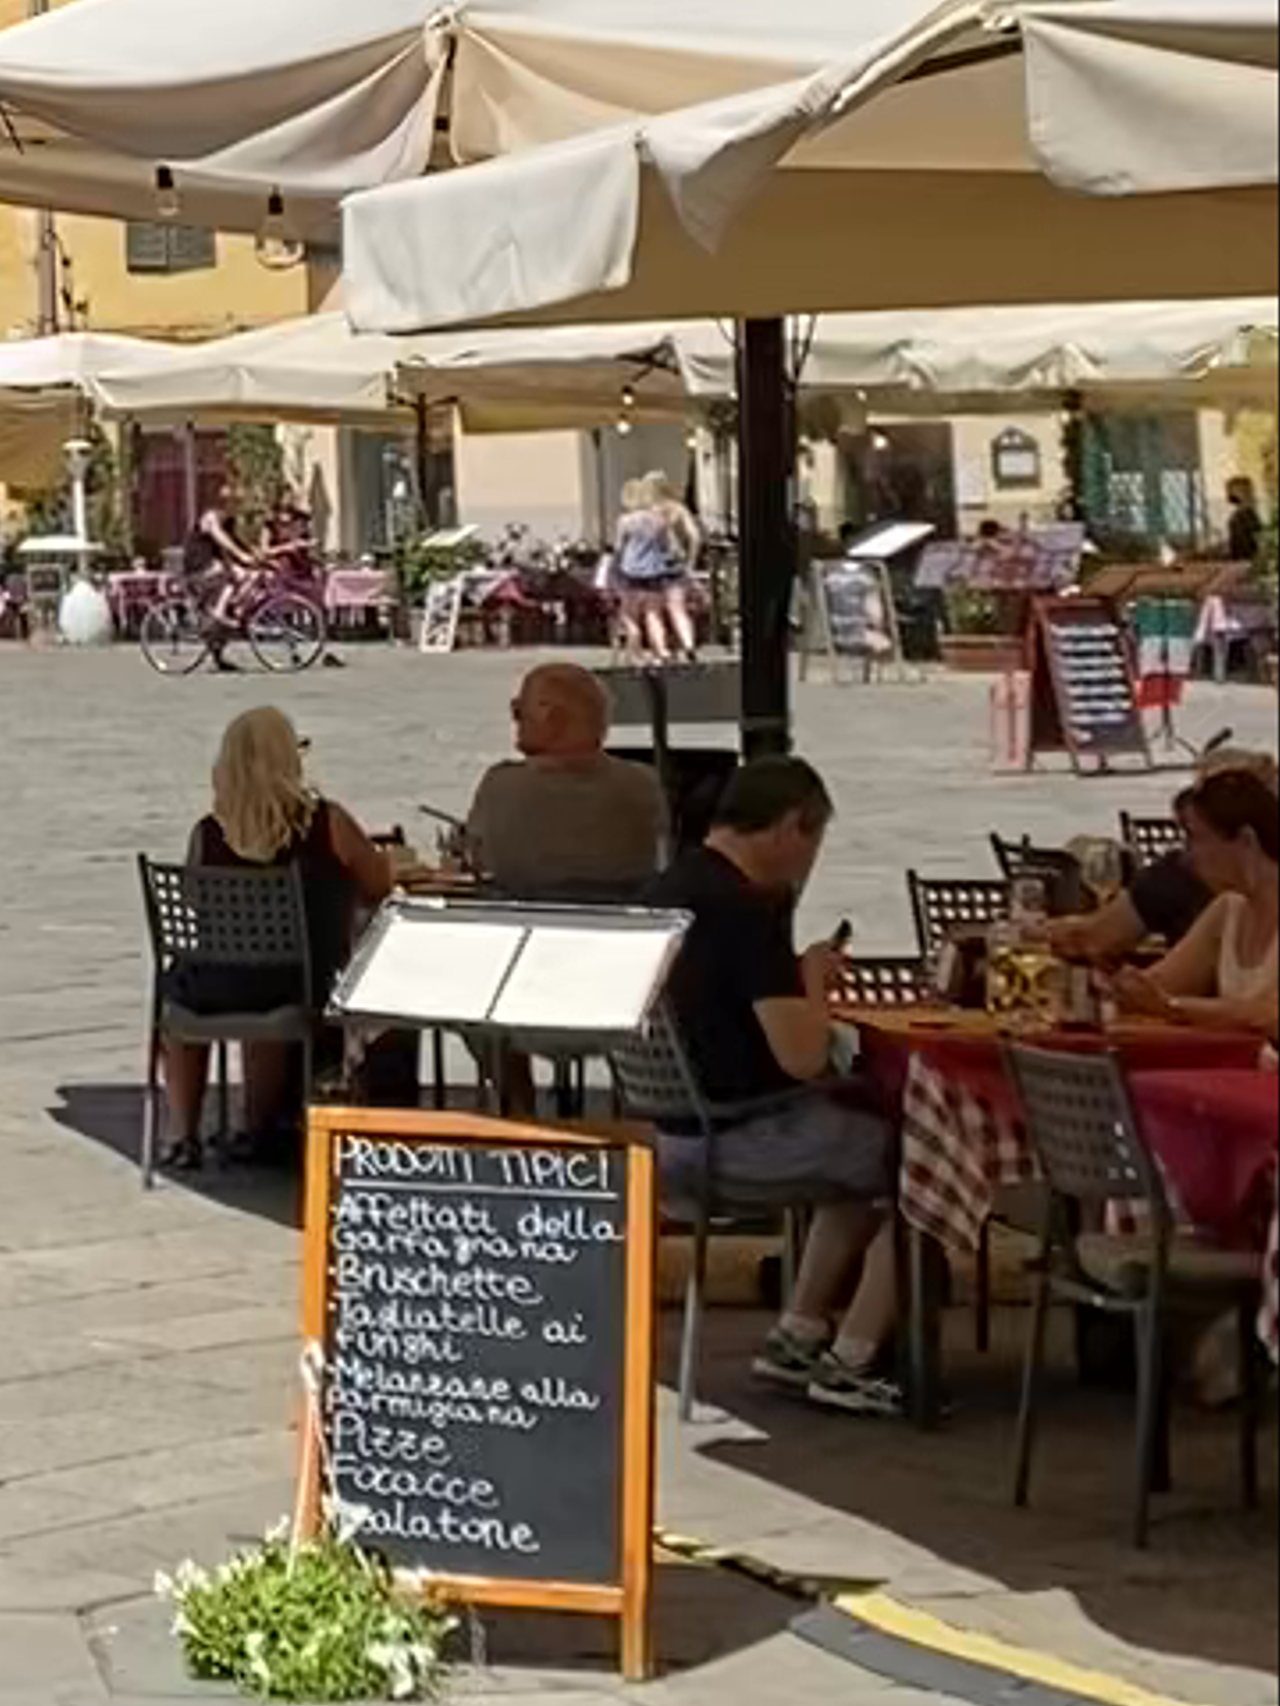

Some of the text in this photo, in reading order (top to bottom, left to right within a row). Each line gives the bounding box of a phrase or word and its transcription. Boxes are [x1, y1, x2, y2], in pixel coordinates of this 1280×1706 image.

[333, 1136, 608, 1191] PRODOTTI TIPICI
[517, 1205, 625, 1241] della
[336, 1252, 542, 1304] Bruschette
[542, 1313, 587, 1344] ai
[520, 1377, 600, 1410] alla
